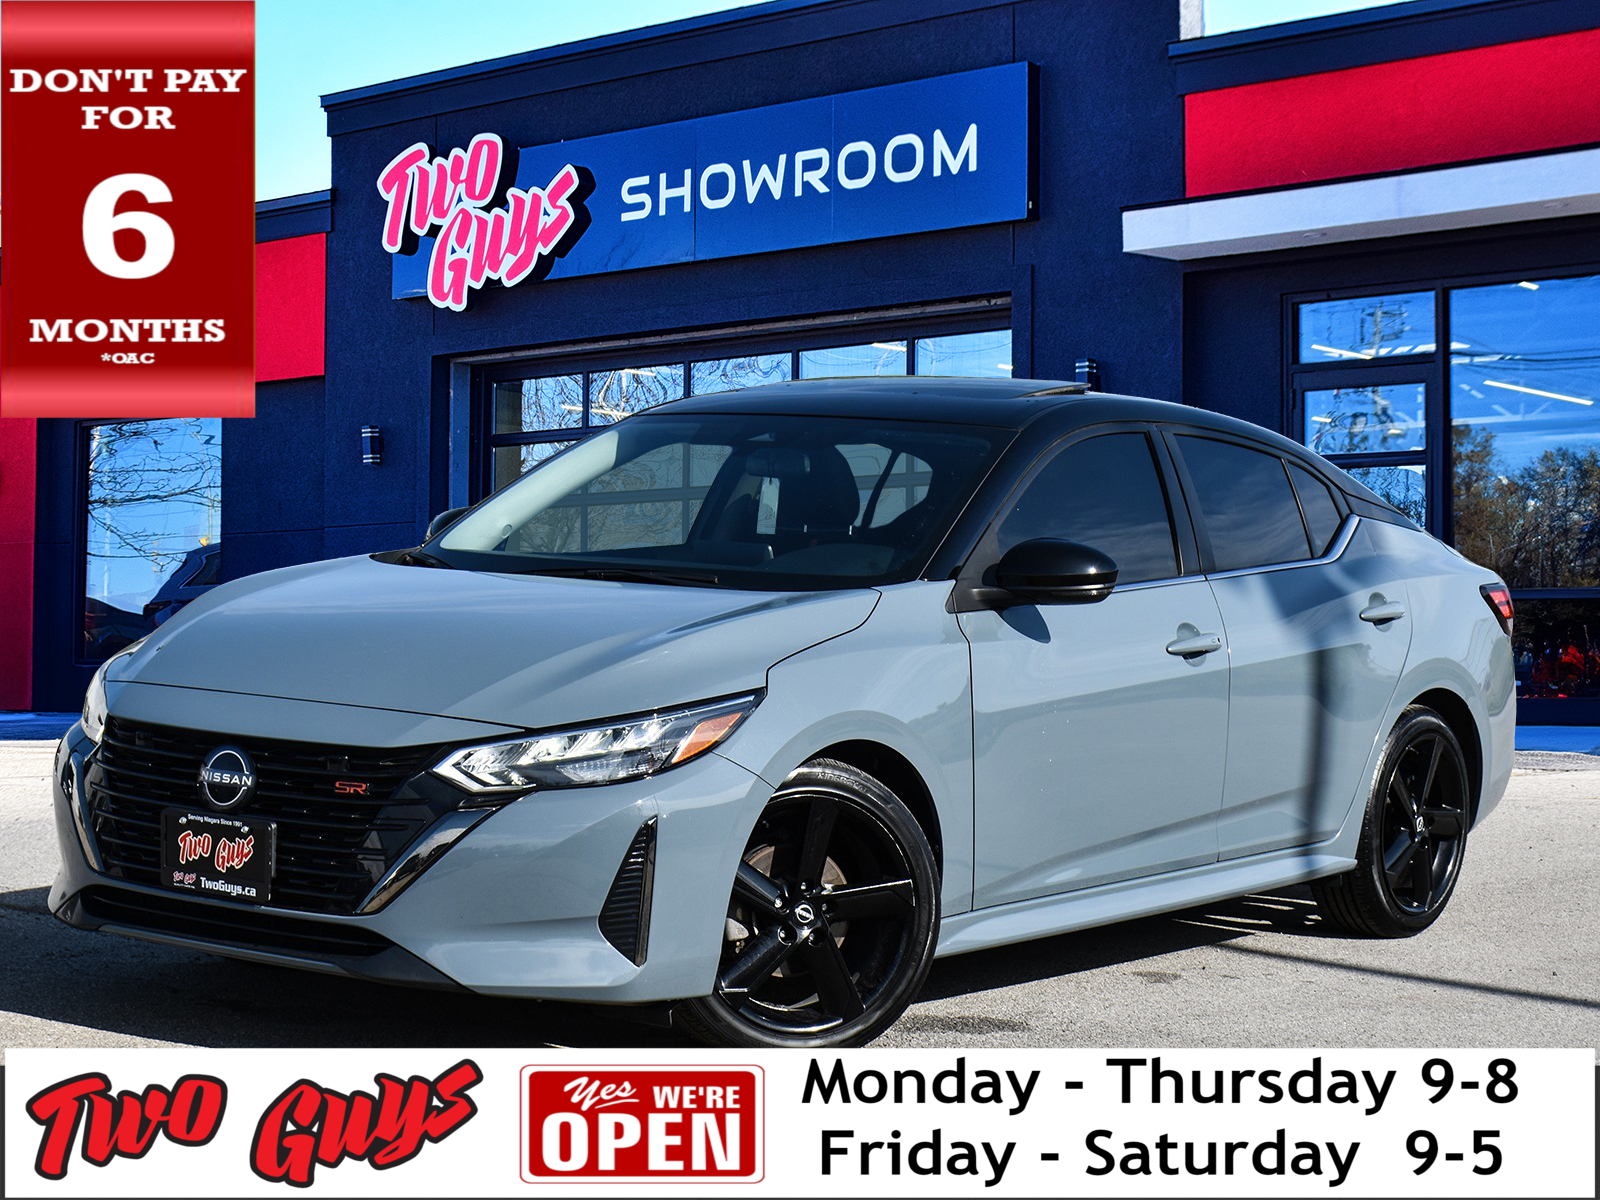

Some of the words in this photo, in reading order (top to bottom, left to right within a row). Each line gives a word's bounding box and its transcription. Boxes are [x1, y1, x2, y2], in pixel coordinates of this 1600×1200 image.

[620, 122, 978, 223] SHOWROOM
[201, 770, 252, 786] NISSAN
[335, 781, 367, 795] SR
[200, 876, 257, 898] TwoGuys.ca
